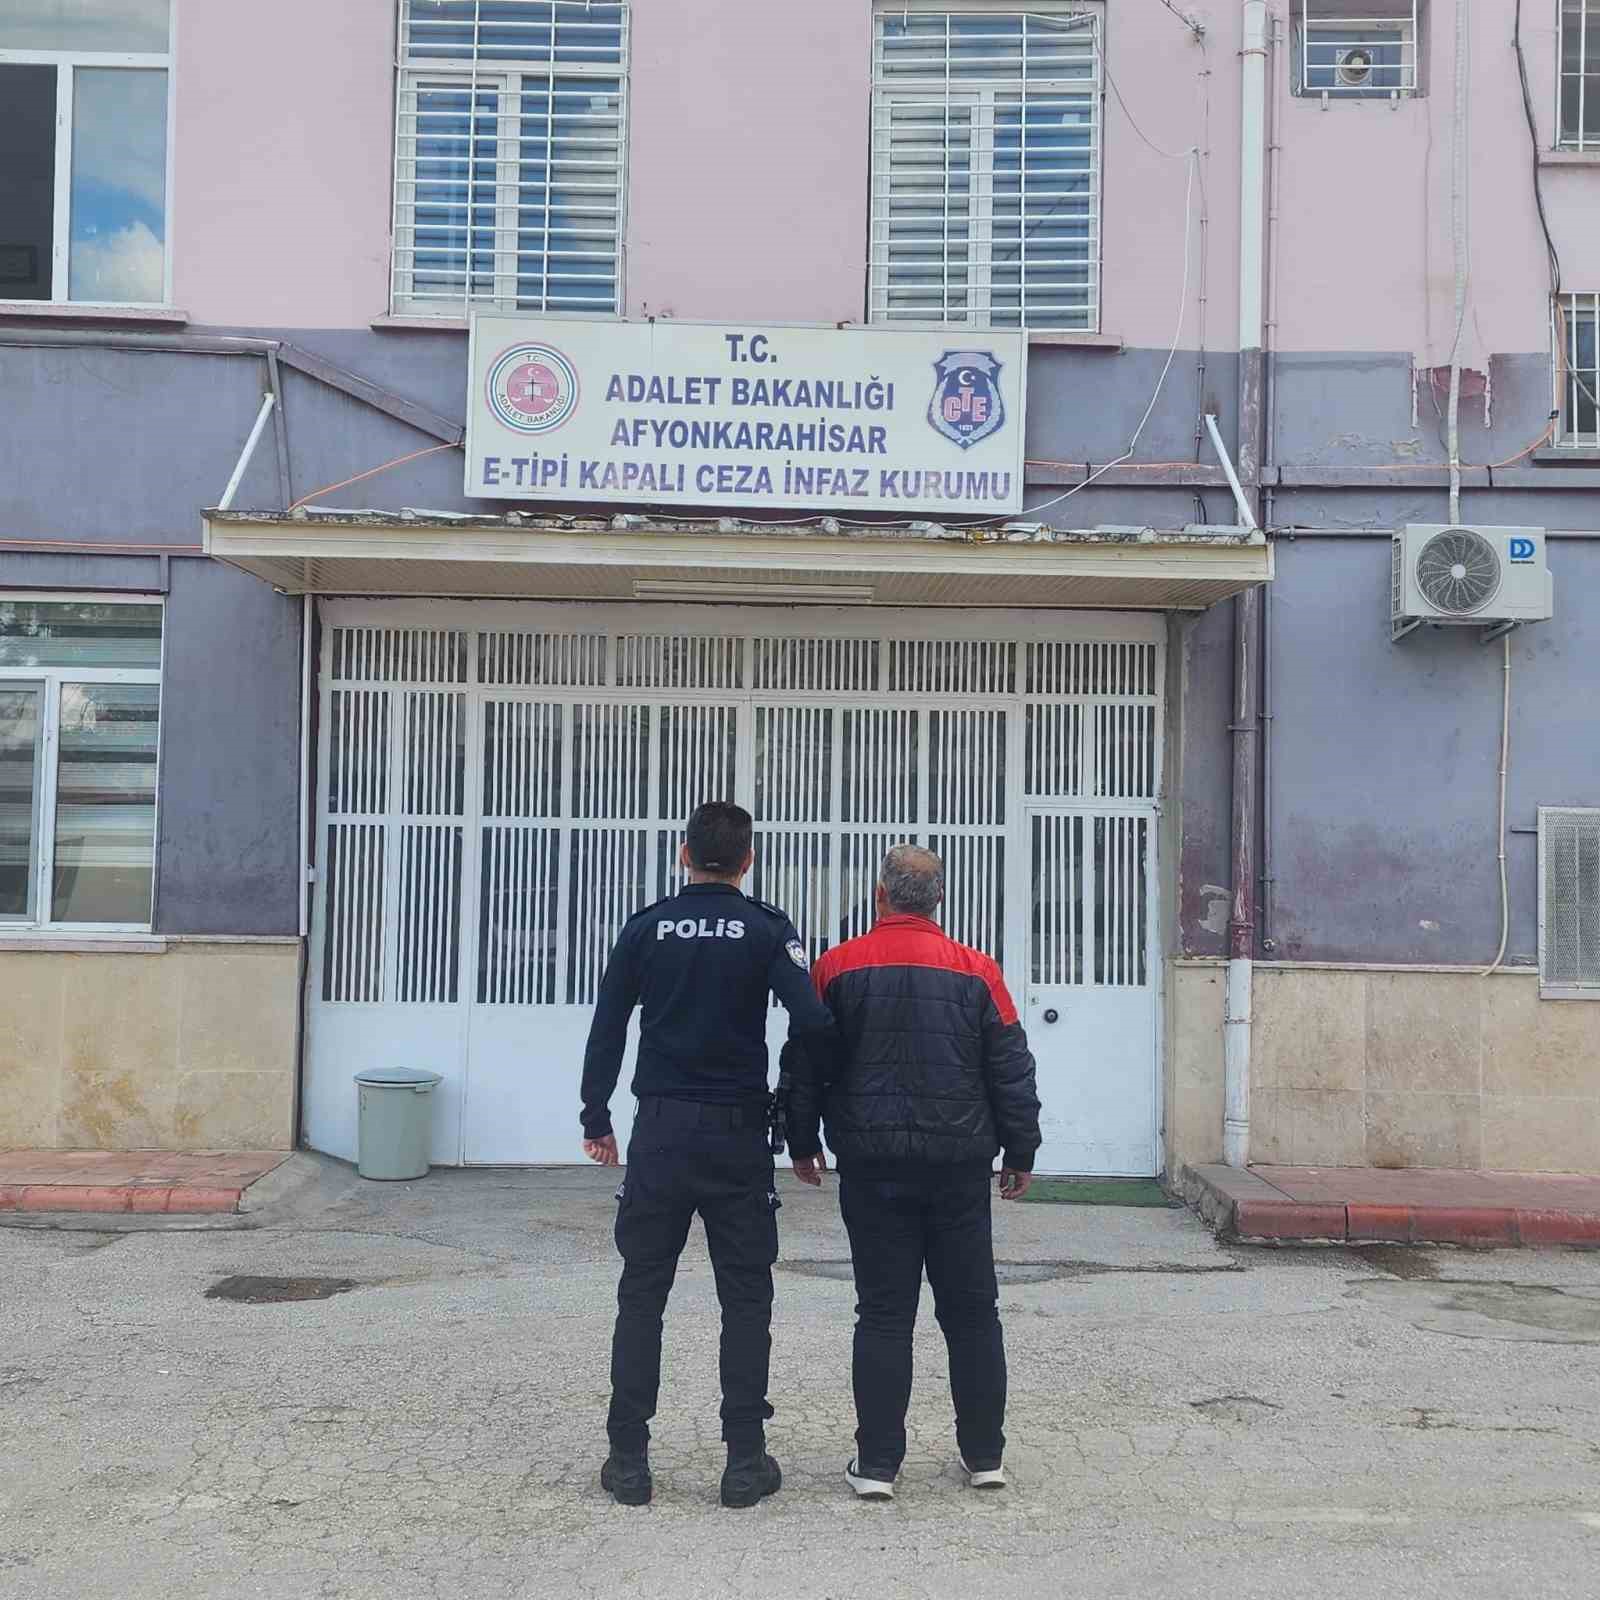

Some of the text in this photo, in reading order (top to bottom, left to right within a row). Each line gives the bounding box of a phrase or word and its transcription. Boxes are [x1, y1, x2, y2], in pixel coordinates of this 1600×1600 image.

[725, 334, 777, 363] T.C.
[606, 374, 894, 410] ADALET BAKANLIĞI
[944, 386, 987, 422] CTE
[610, 417, 887, 454] AFYONKARAHİSAR
[483, 452, 1010, 500] E-TİPİ KAPALI CEZA İNFAZ KURUMU
